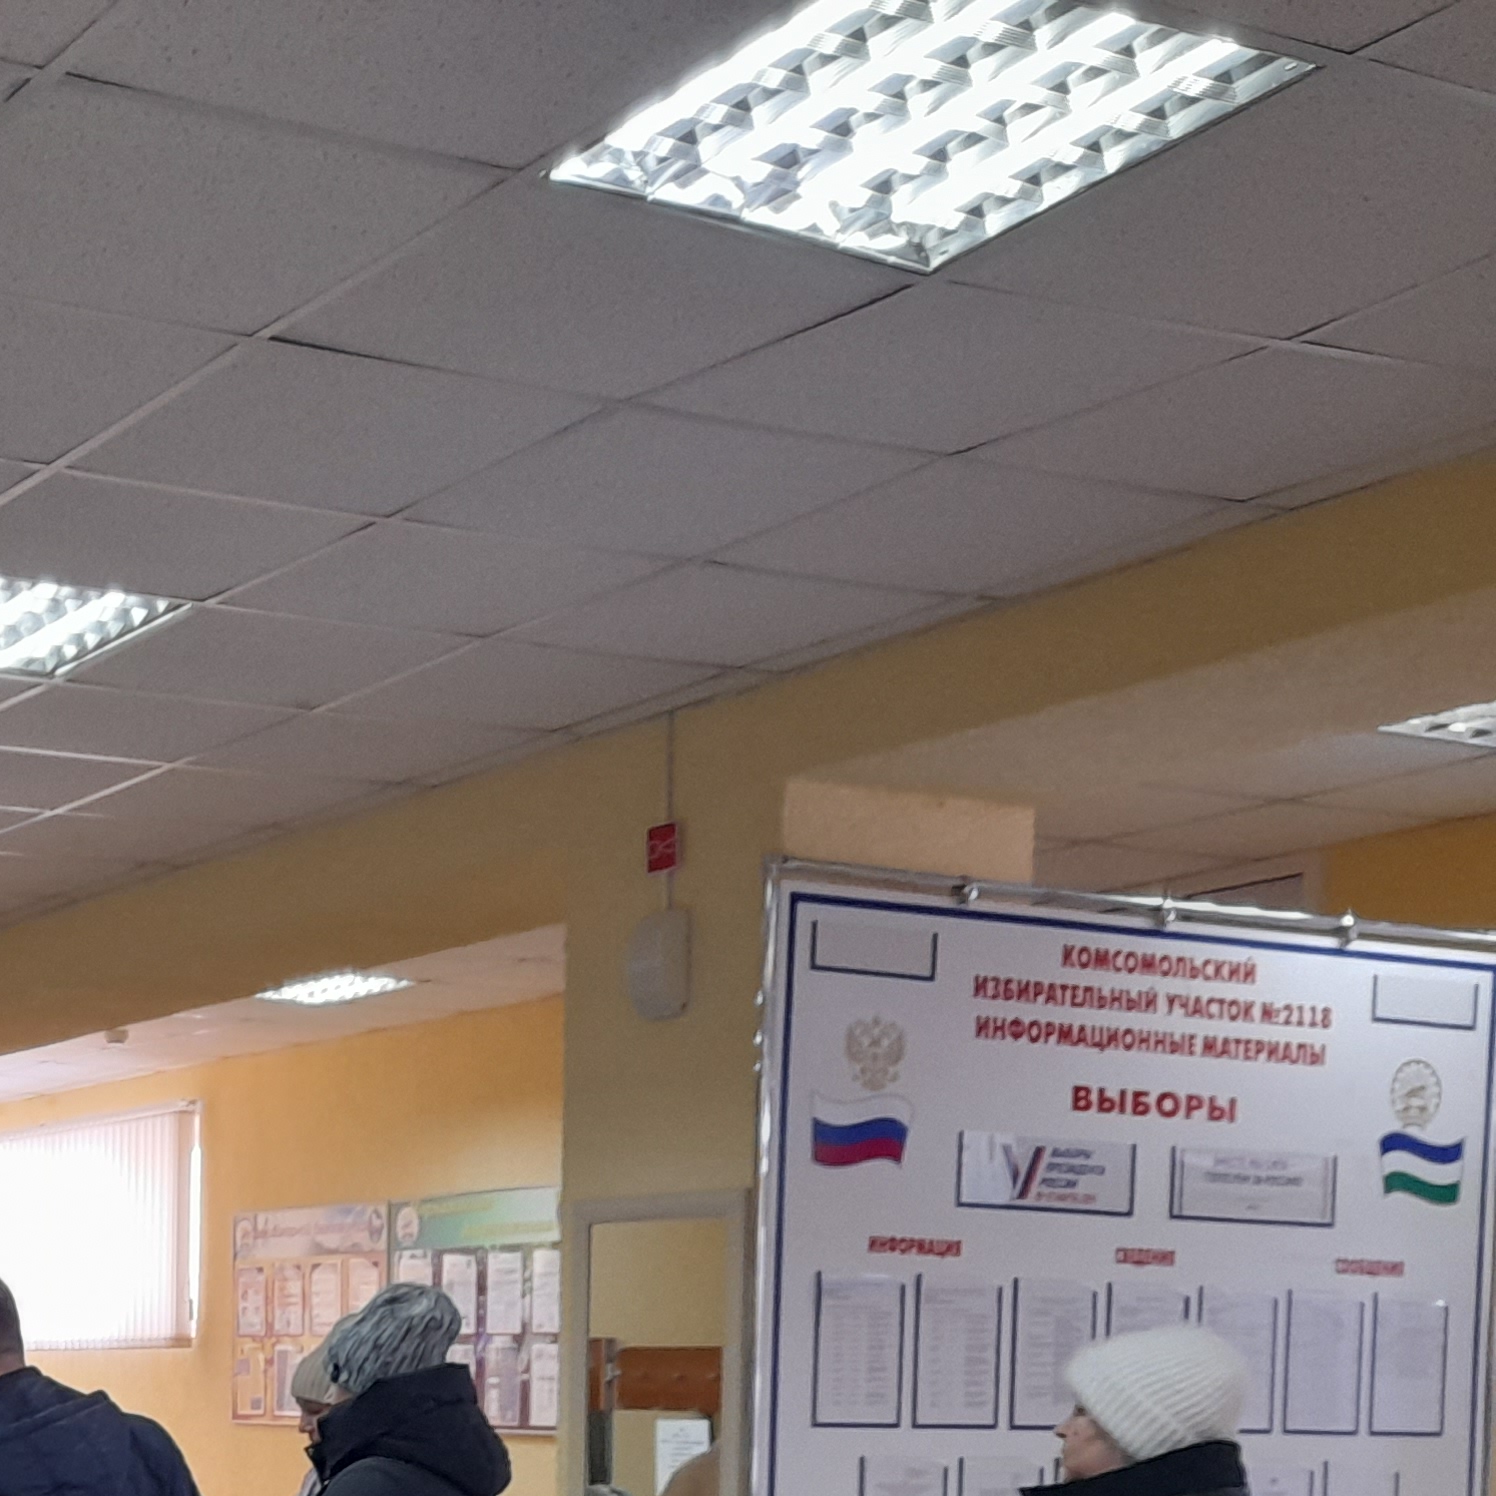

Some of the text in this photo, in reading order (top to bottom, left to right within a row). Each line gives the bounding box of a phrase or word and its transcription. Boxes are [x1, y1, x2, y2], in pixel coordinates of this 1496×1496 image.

[1061, 943, 1257, 984] КОМСОМОЛЬСКИЙ
[973, 973, 1332, 1029] ИЗБИРАТЕЛЬНЫЙ УЧАСТОК №2118
[975, 1014, 1326, 1065] ИНФОРМАЦИОННЫЕ МАТЕРИАЛЫ
[1071, 1085, 1237, 1124] ВЫБОРЫ
[868, 1235, 962, 1257] ИНФОРМАЦИЯ
